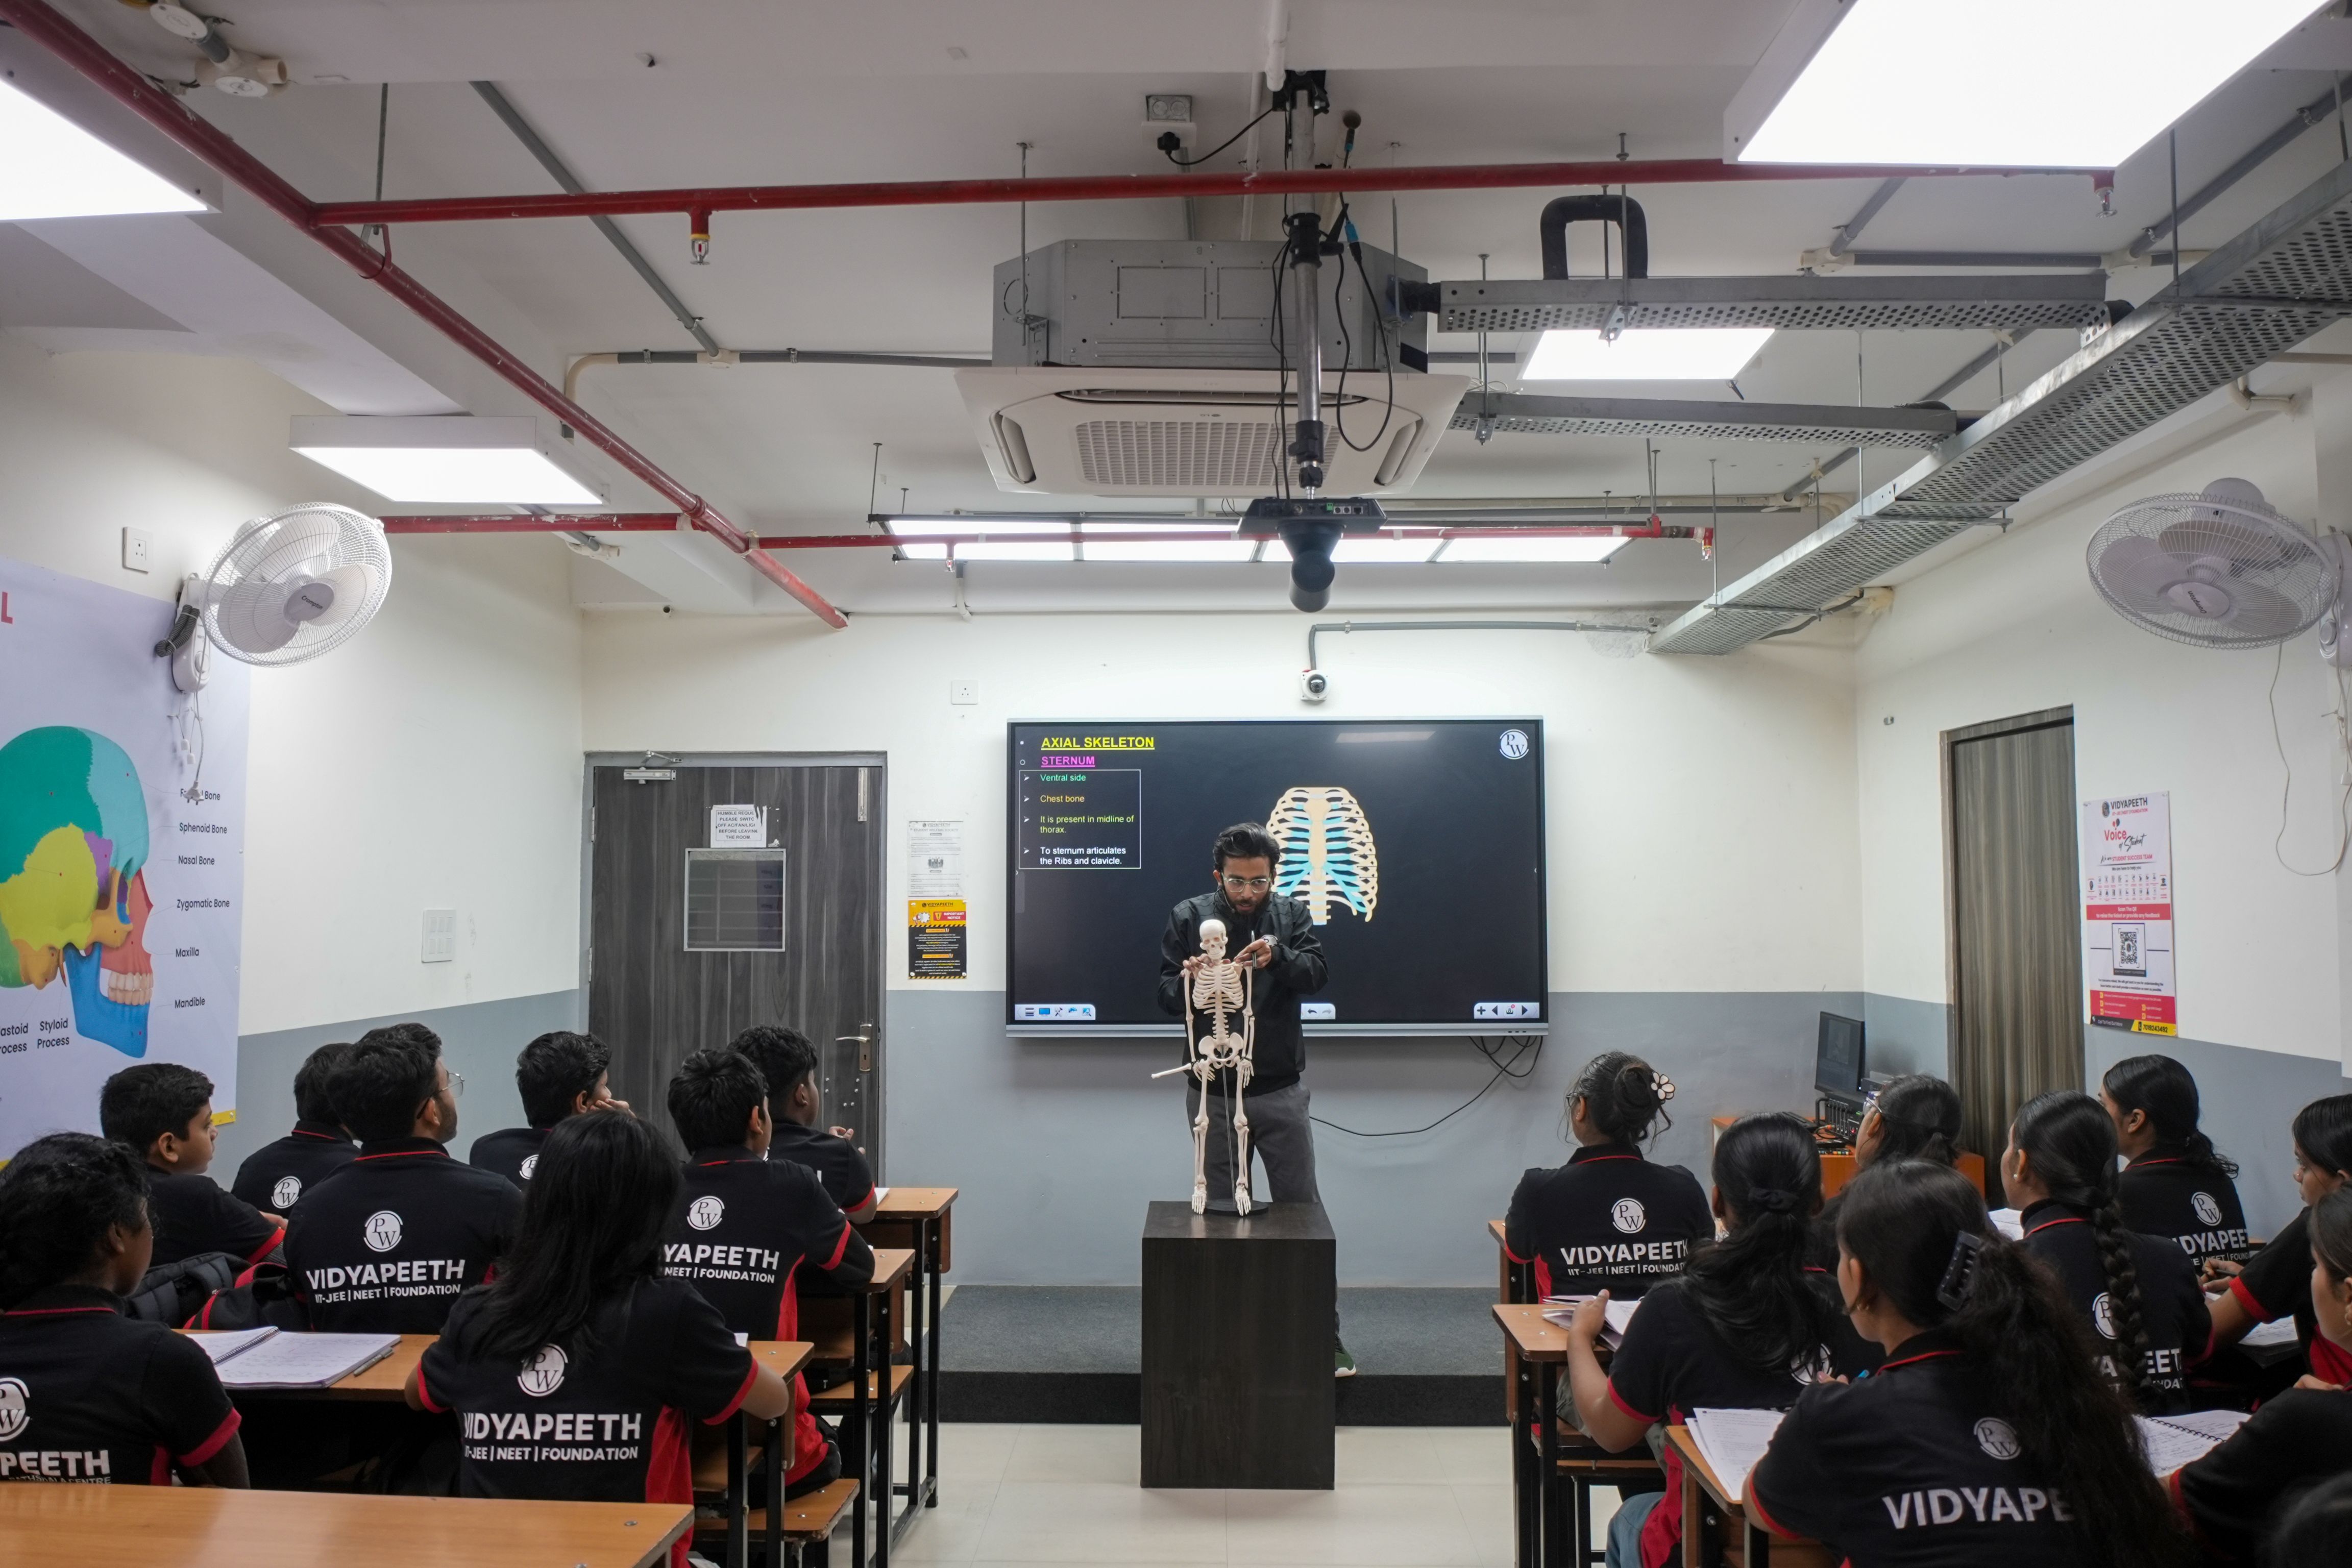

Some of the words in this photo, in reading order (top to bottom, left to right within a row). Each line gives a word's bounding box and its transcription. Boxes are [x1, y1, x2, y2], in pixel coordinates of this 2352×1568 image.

[301, 595, 323, 610] Crompton
[2188, 591, 2207, 614] Crompton
[1041, 737, 1081, 748] AXIAL
[1084, 737, 1154, 748] SKELETON
[1041, 756, 1095, 765] STERNUM
[205, 791, 220, 800] Bone
[2111, 797, 2148, 810] VIDYAPEETH
[1057, 816, 1085, 824] present
[179, 822, 210, 835] Sphenoid
[211, 824, 228, 834] Bone
[2104, 827, 2127, 841] Voice
[1086, 846, 1126, 854] articulates
[2124, 833, 2147, 852] Student
[179, 855, 198, 865] Nasal
[199, 856, 215, 865] Bone
[177, 898, 212, 911] Zygomatic
[214, 899, 230, 908] Bone
[176, 947, 199, 958] Maxilla
[175, 997, 205, 1009] Mandible
[0, 1022, 29, 1037] astoid
[40, 1018, 68, 1034] Styloid
[0, 1043, 28, 1054] ocess
[37, 1037, 70, 1049] Process
[2170, 1228, 2248, 1255] DYAPEE
[664, 1243, 780, 1270] YAPEETH
[306, 1259, 465, 1290] VIDYAPEETH
[665, 1267, 692, 1277] NEET
[699, 1268, 775, 1284] FOUNDATION
[1567, 1267, 1604, 1276] IIT-JEE
[1611, 1265, 1636, 1275] NEET
[1643, 1262, 1686, 1273] FOUNDAT
[353, 1288, 382, 1300] NEET
[390, 1284, 461, 1297] FOUNDATION
[463, 1412, 642, 1441] VIDYAPEETH
[496, 1447, 532, 1460] NEET
[542, 1446, 639, 1461] FOUNDATION
[0, 1450, 111, 1477] PEETH
[1882, 1487, 2075, 1530] VIDYAPE
